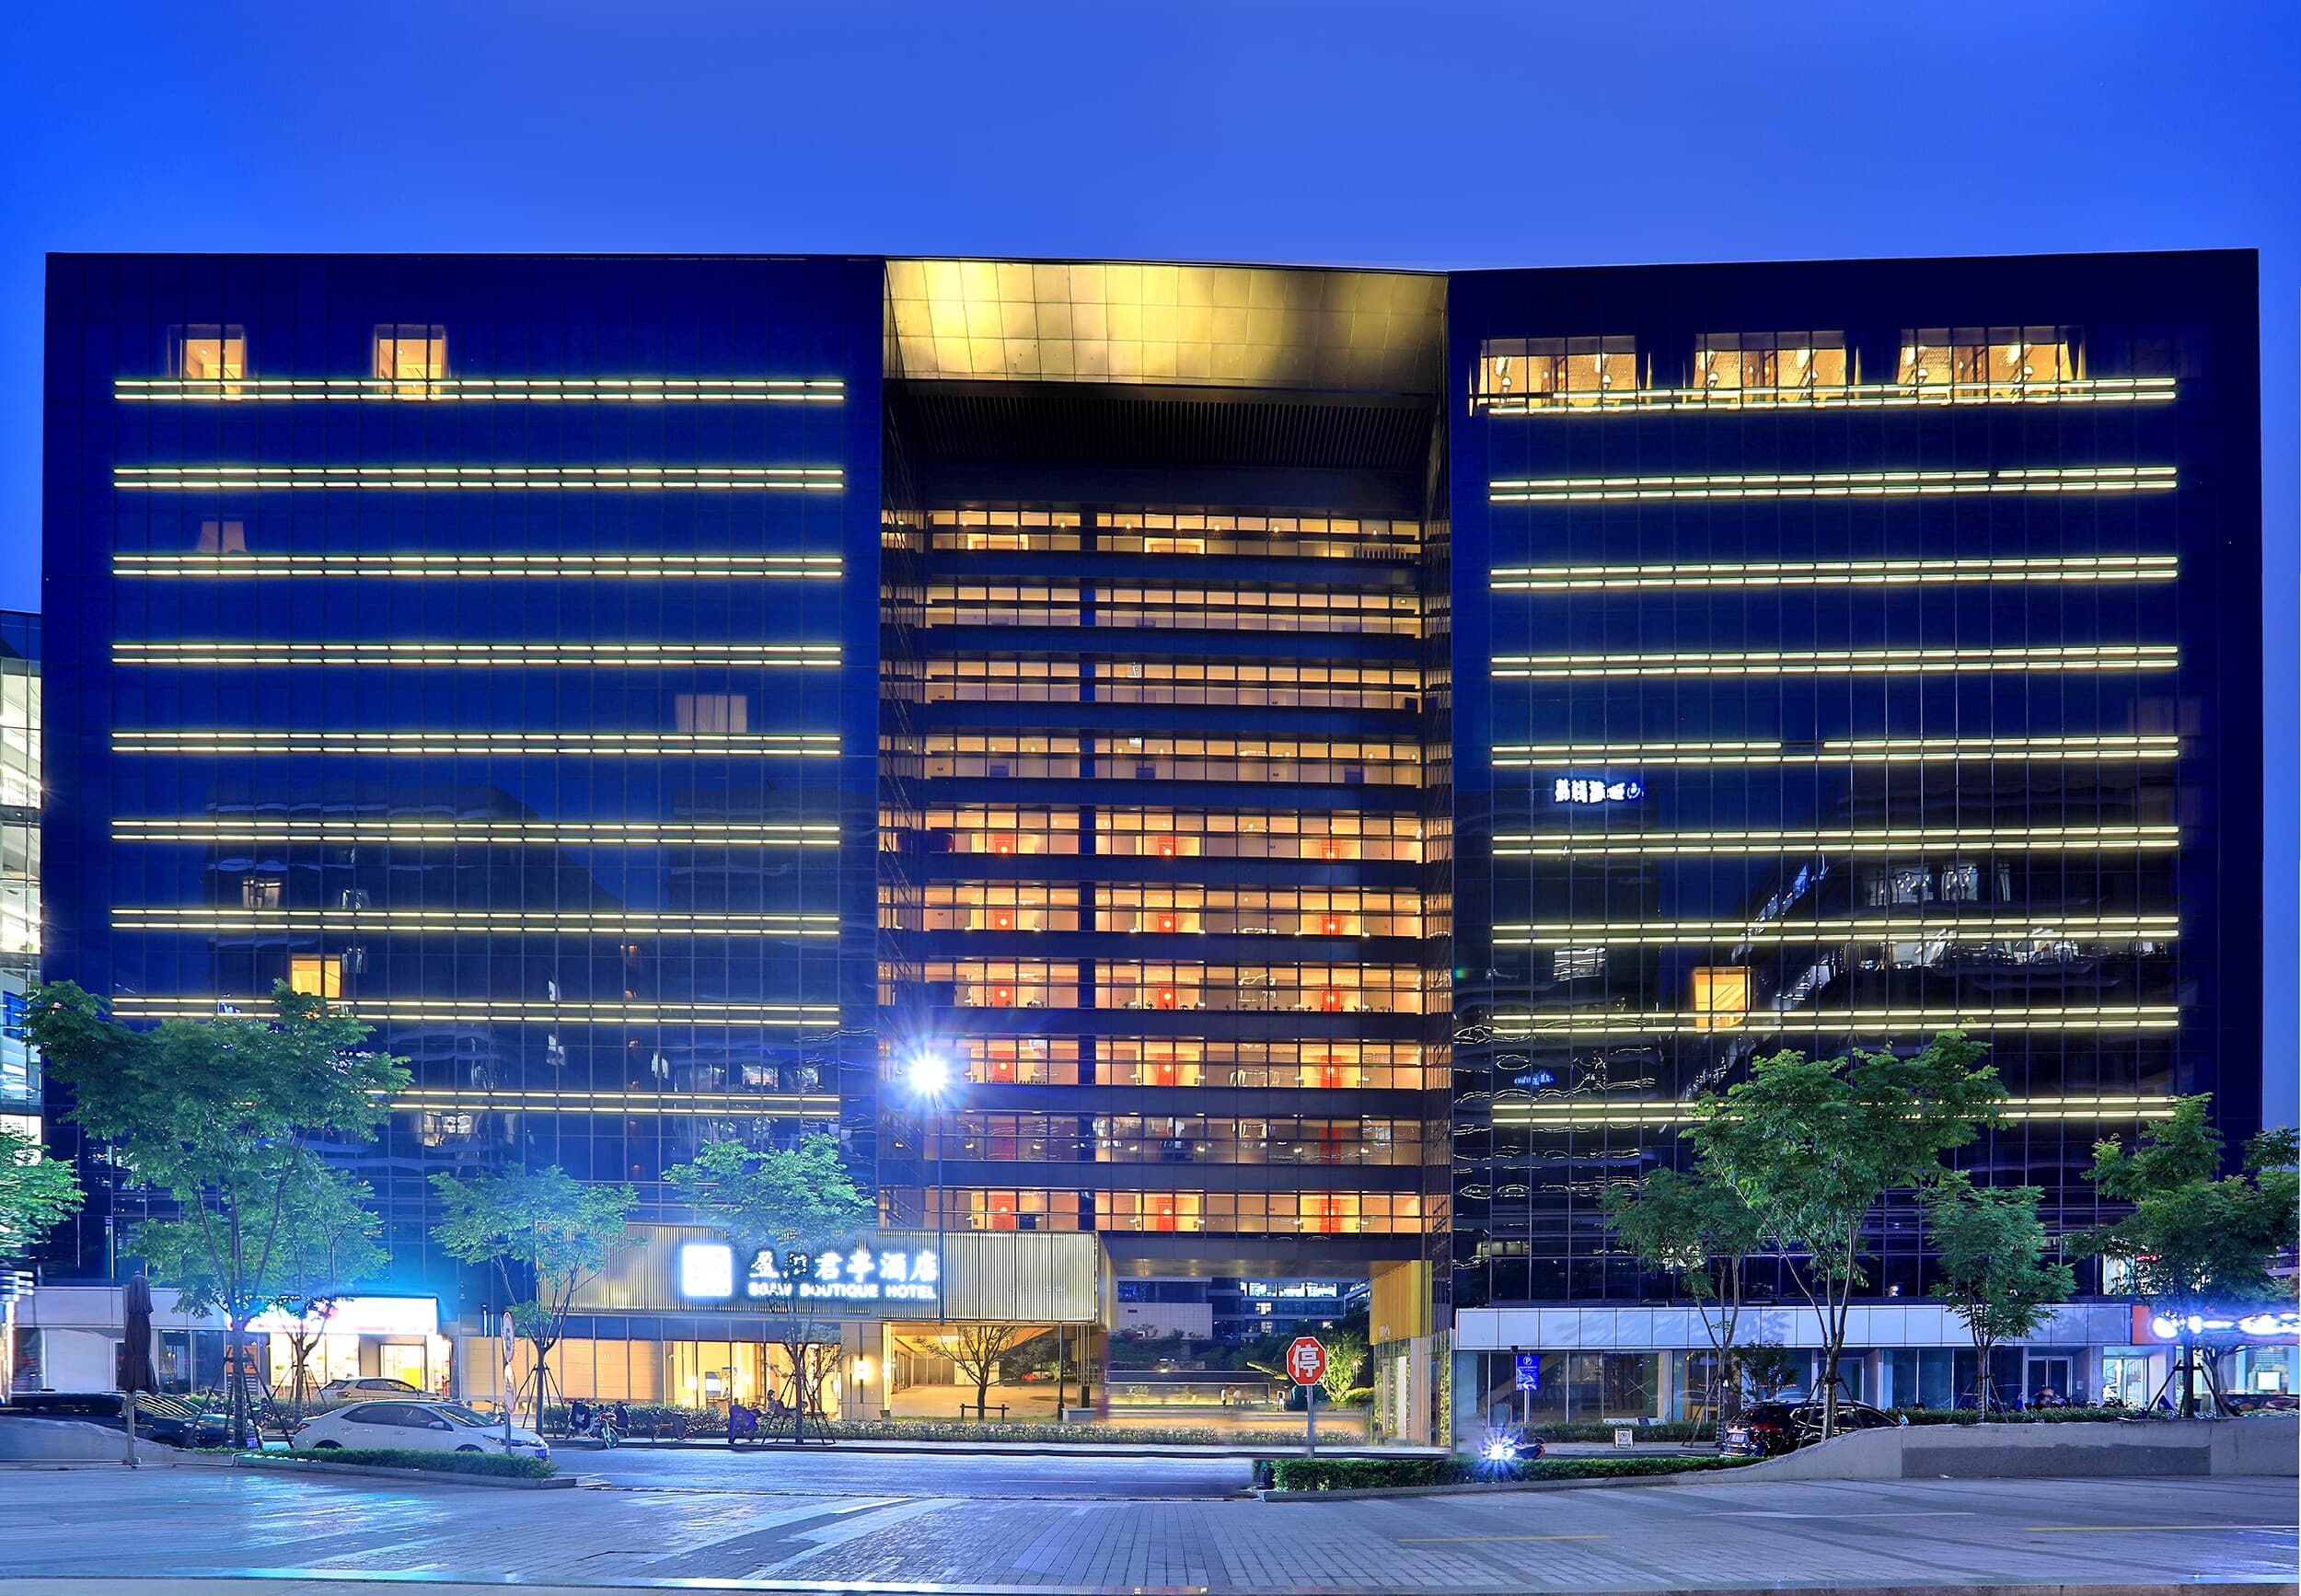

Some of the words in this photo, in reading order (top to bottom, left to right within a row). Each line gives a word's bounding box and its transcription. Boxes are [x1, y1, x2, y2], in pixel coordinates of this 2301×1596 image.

[800, 1283, 879, 1298] BOUTIQUE
[885, 1284, 937, 1299] HOTEL
[1291, 1343, 1321, 1378] 停
